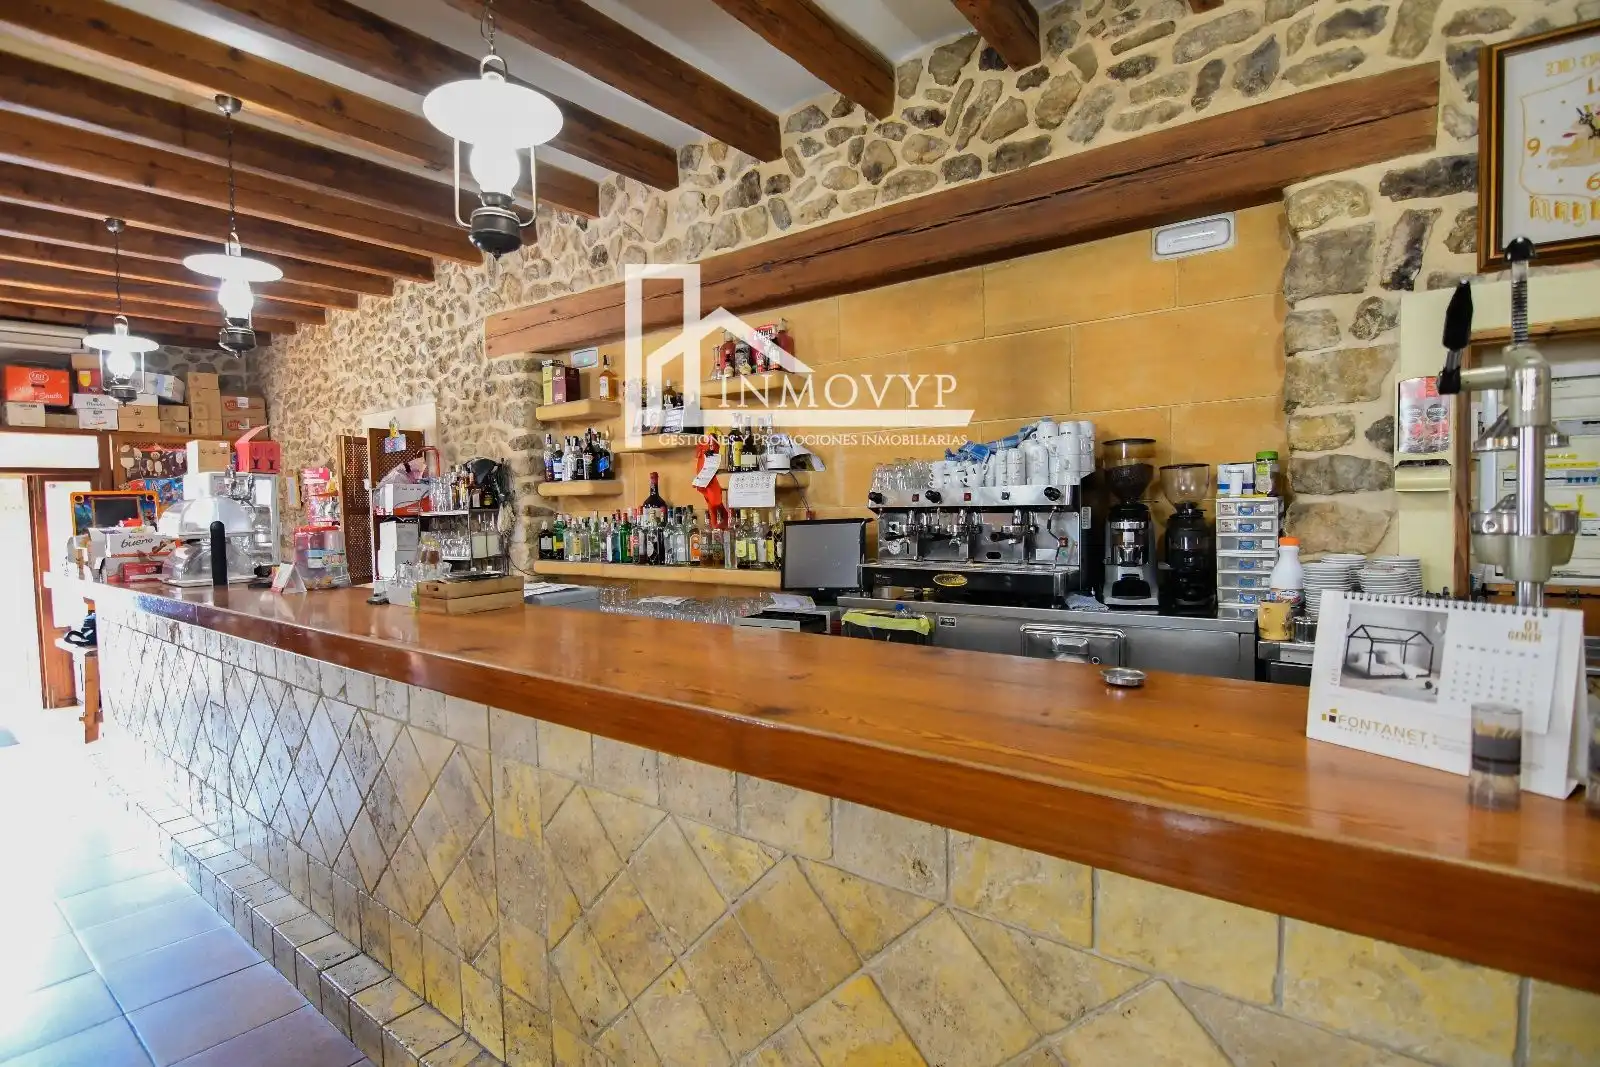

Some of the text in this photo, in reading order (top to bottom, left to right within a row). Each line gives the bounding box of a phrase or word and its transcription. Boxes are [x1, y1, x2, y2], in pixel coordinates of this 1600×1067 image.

[1527, 137, 1541, 157] 9
[1586, 171, 1600, 191] 6
[121, 537, 154, 549] bueno
[1524, 620, 1539, 632] 01
[1337, 713, 1429, 745] FONTANET
